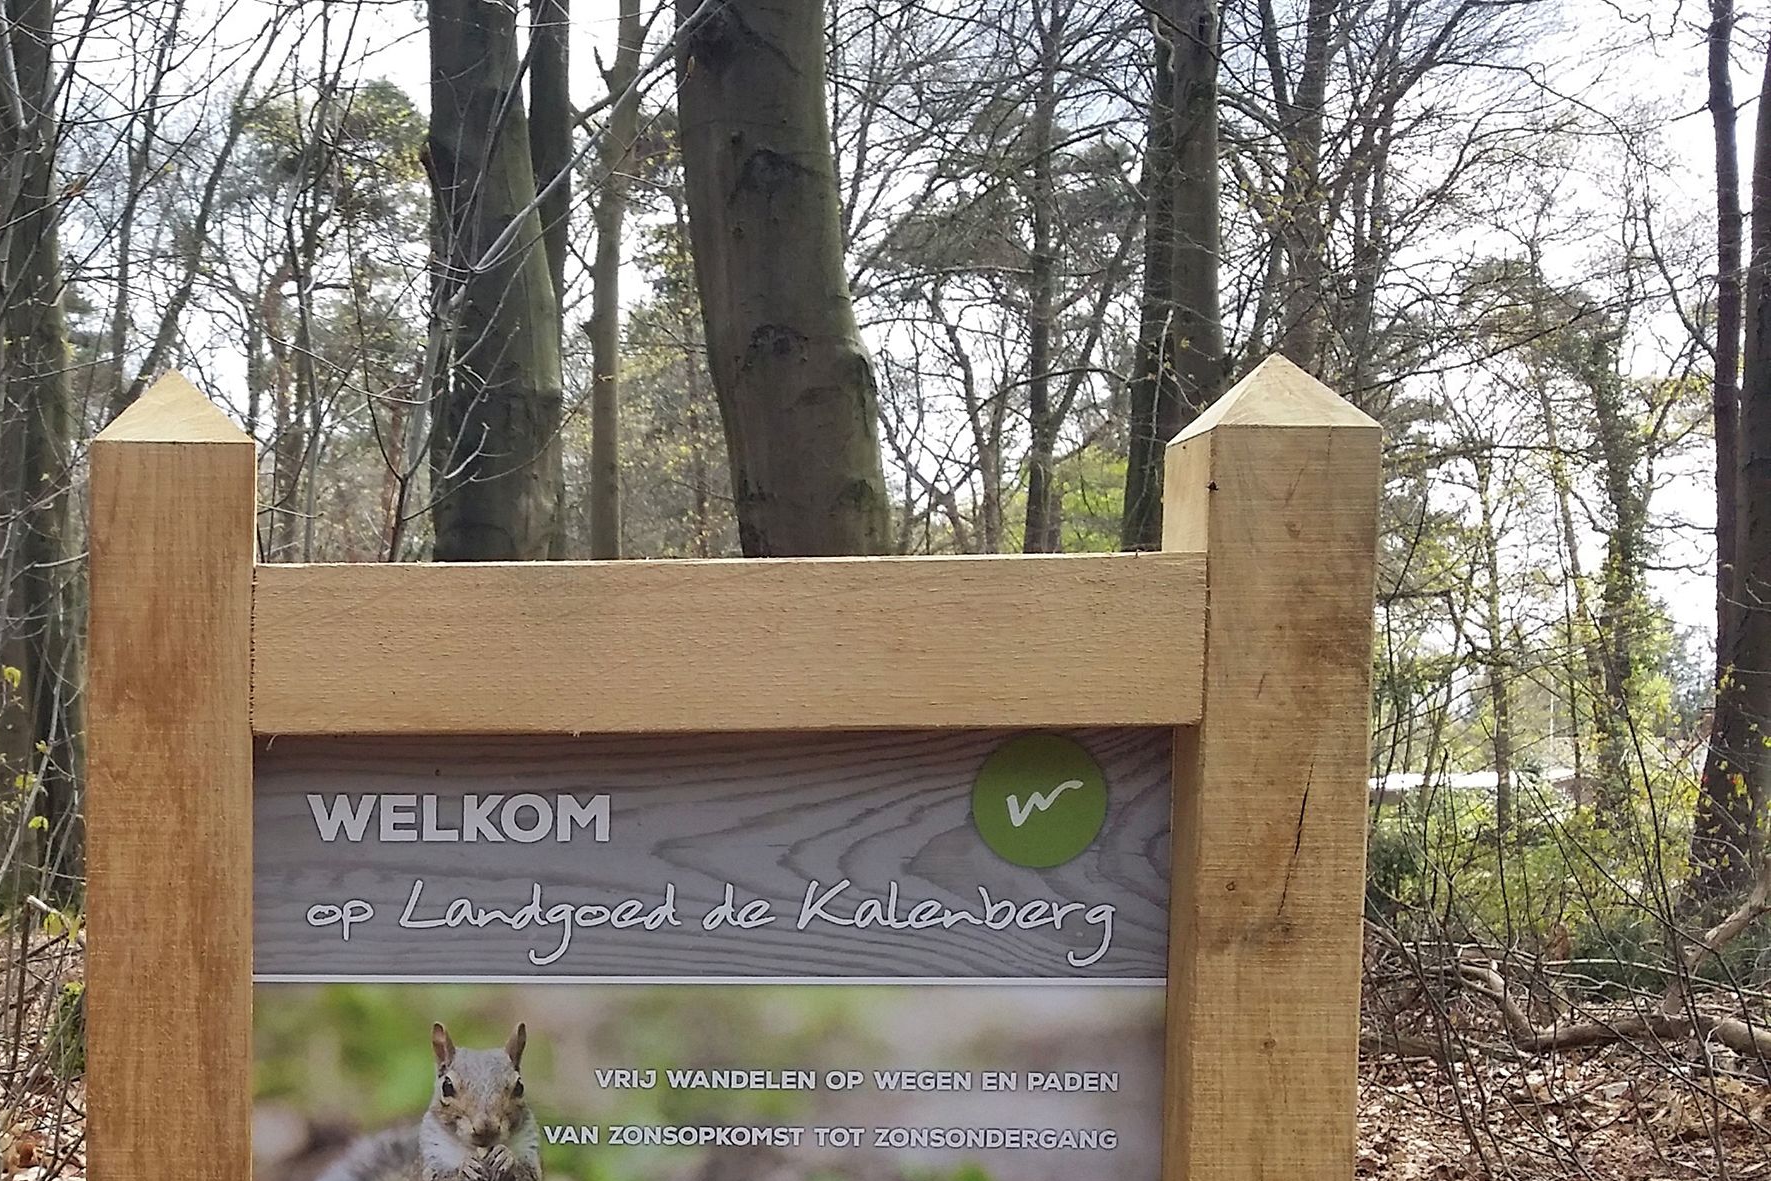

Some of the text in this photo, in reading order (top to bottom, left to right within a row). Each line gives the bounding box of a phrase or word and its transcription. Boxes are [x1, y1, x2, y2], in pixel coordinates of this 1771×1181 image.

[307, 793, 610, 842] WELKOM
[306, 879, 1117, 968] op Landgoed de Kalenberg
[595, 1069, 1119, 1092] VRIJ WANDELEN OP WEGEN EN PADEN
[544, 1126, 1118, 1149] VAN ZONSOPKOMST TOT ZONSONDERGANG
